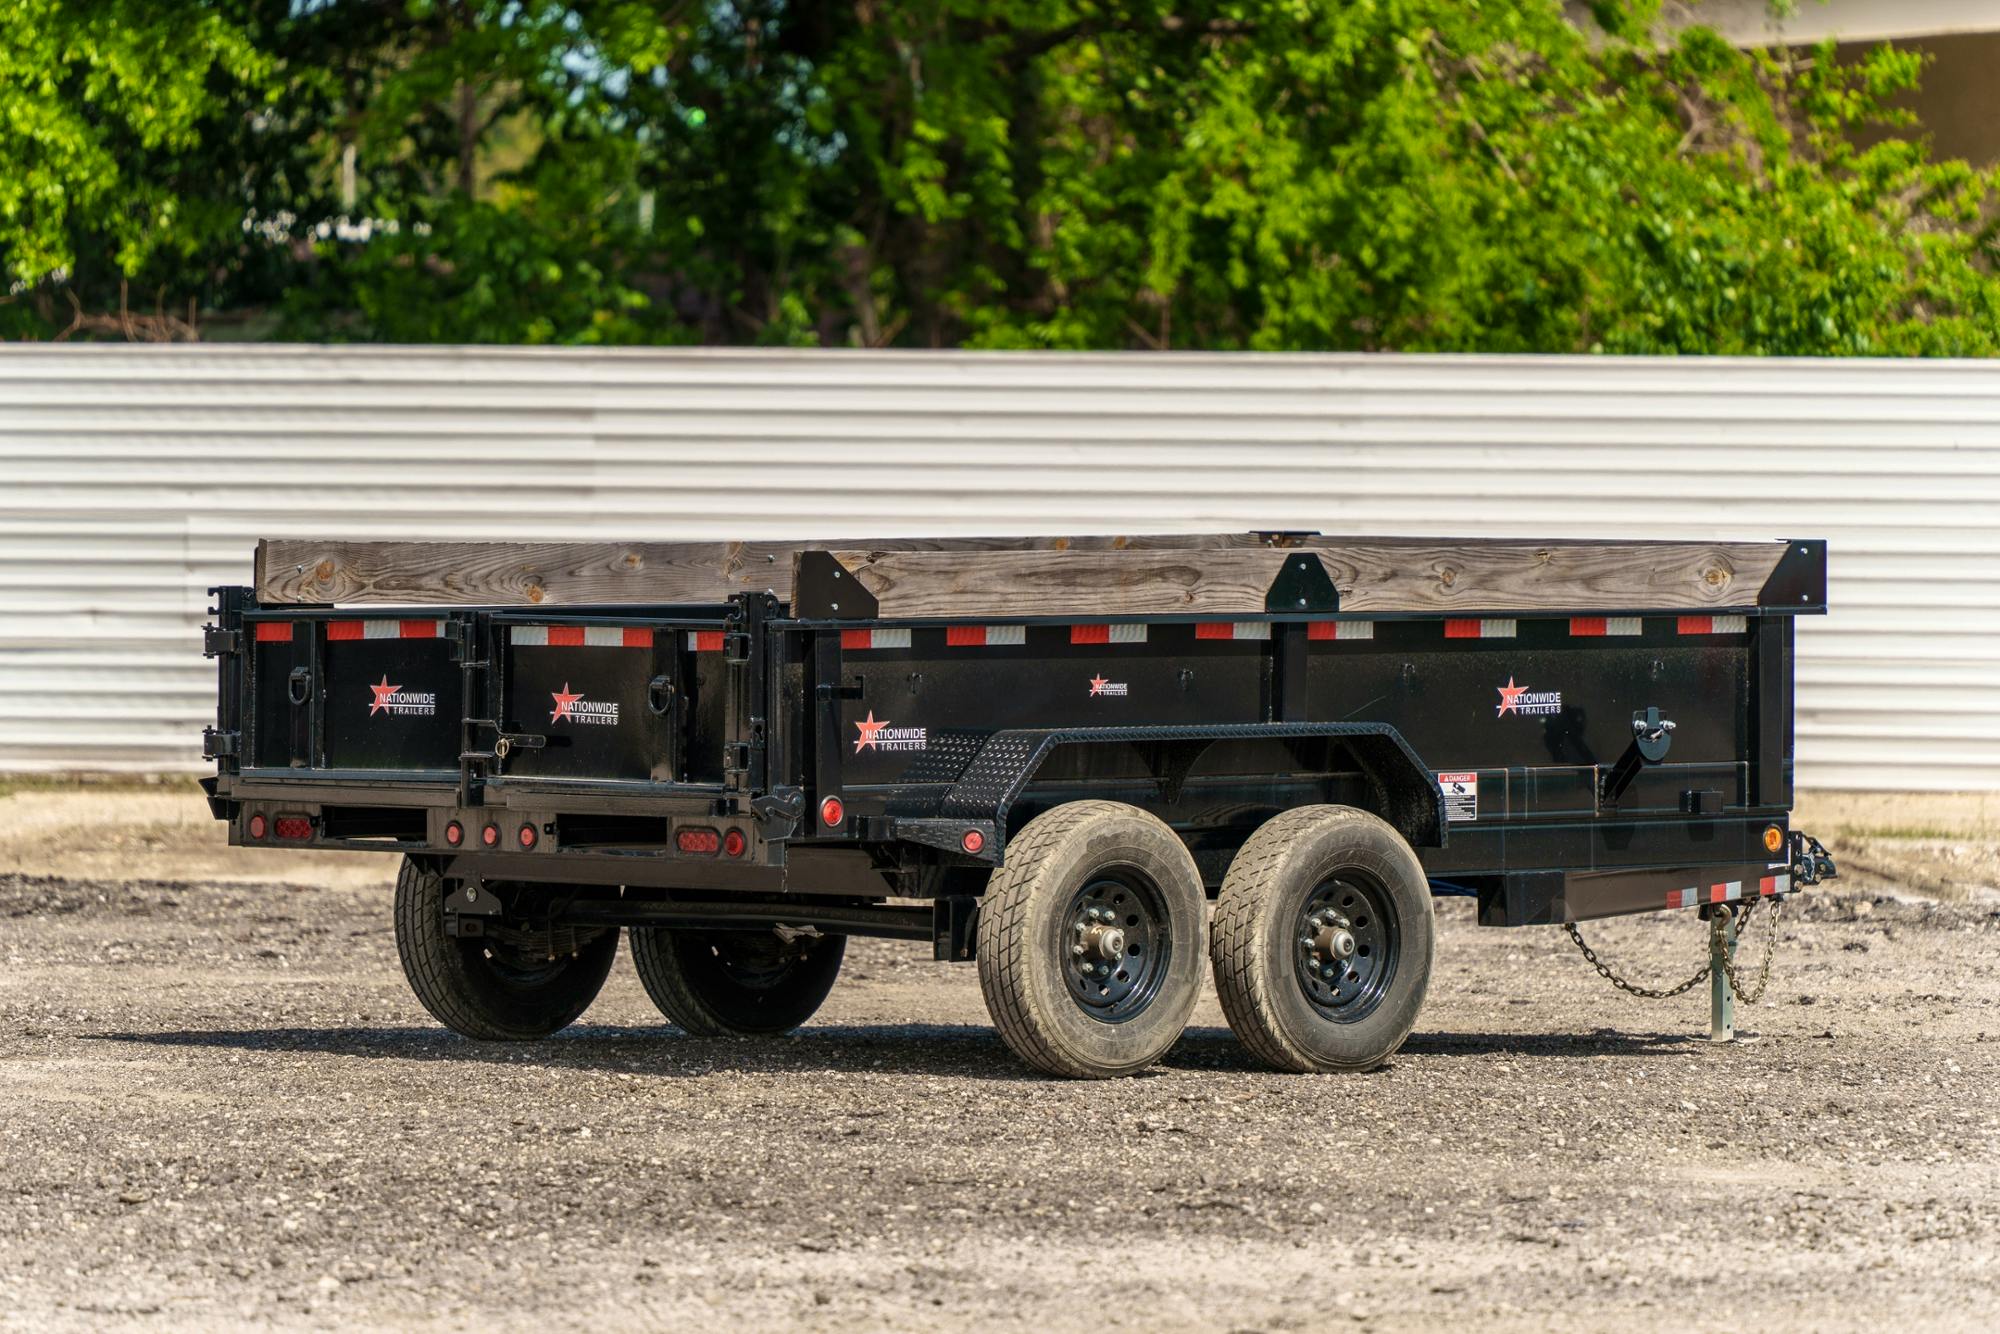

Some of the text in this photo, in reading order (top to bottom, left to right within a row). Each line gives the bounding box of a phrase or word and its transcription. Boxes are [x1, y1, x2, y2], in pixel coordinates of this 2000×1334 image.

[379, 692, 436, 704] NATIONWIDE
[1506, 692, 1561, 704] NATIONWIDE
[393, 707, 435, 716] TRAILERS
[561, 701, 619, 714] NATIONWIDE
[1520, 705, 1561, 715] TRAILERS
[575, 715, 618, 726] TRAILERS
[865, 728, 927, 740] NATIONWIDE
[880, 742, 927, 751] TRAILERS
